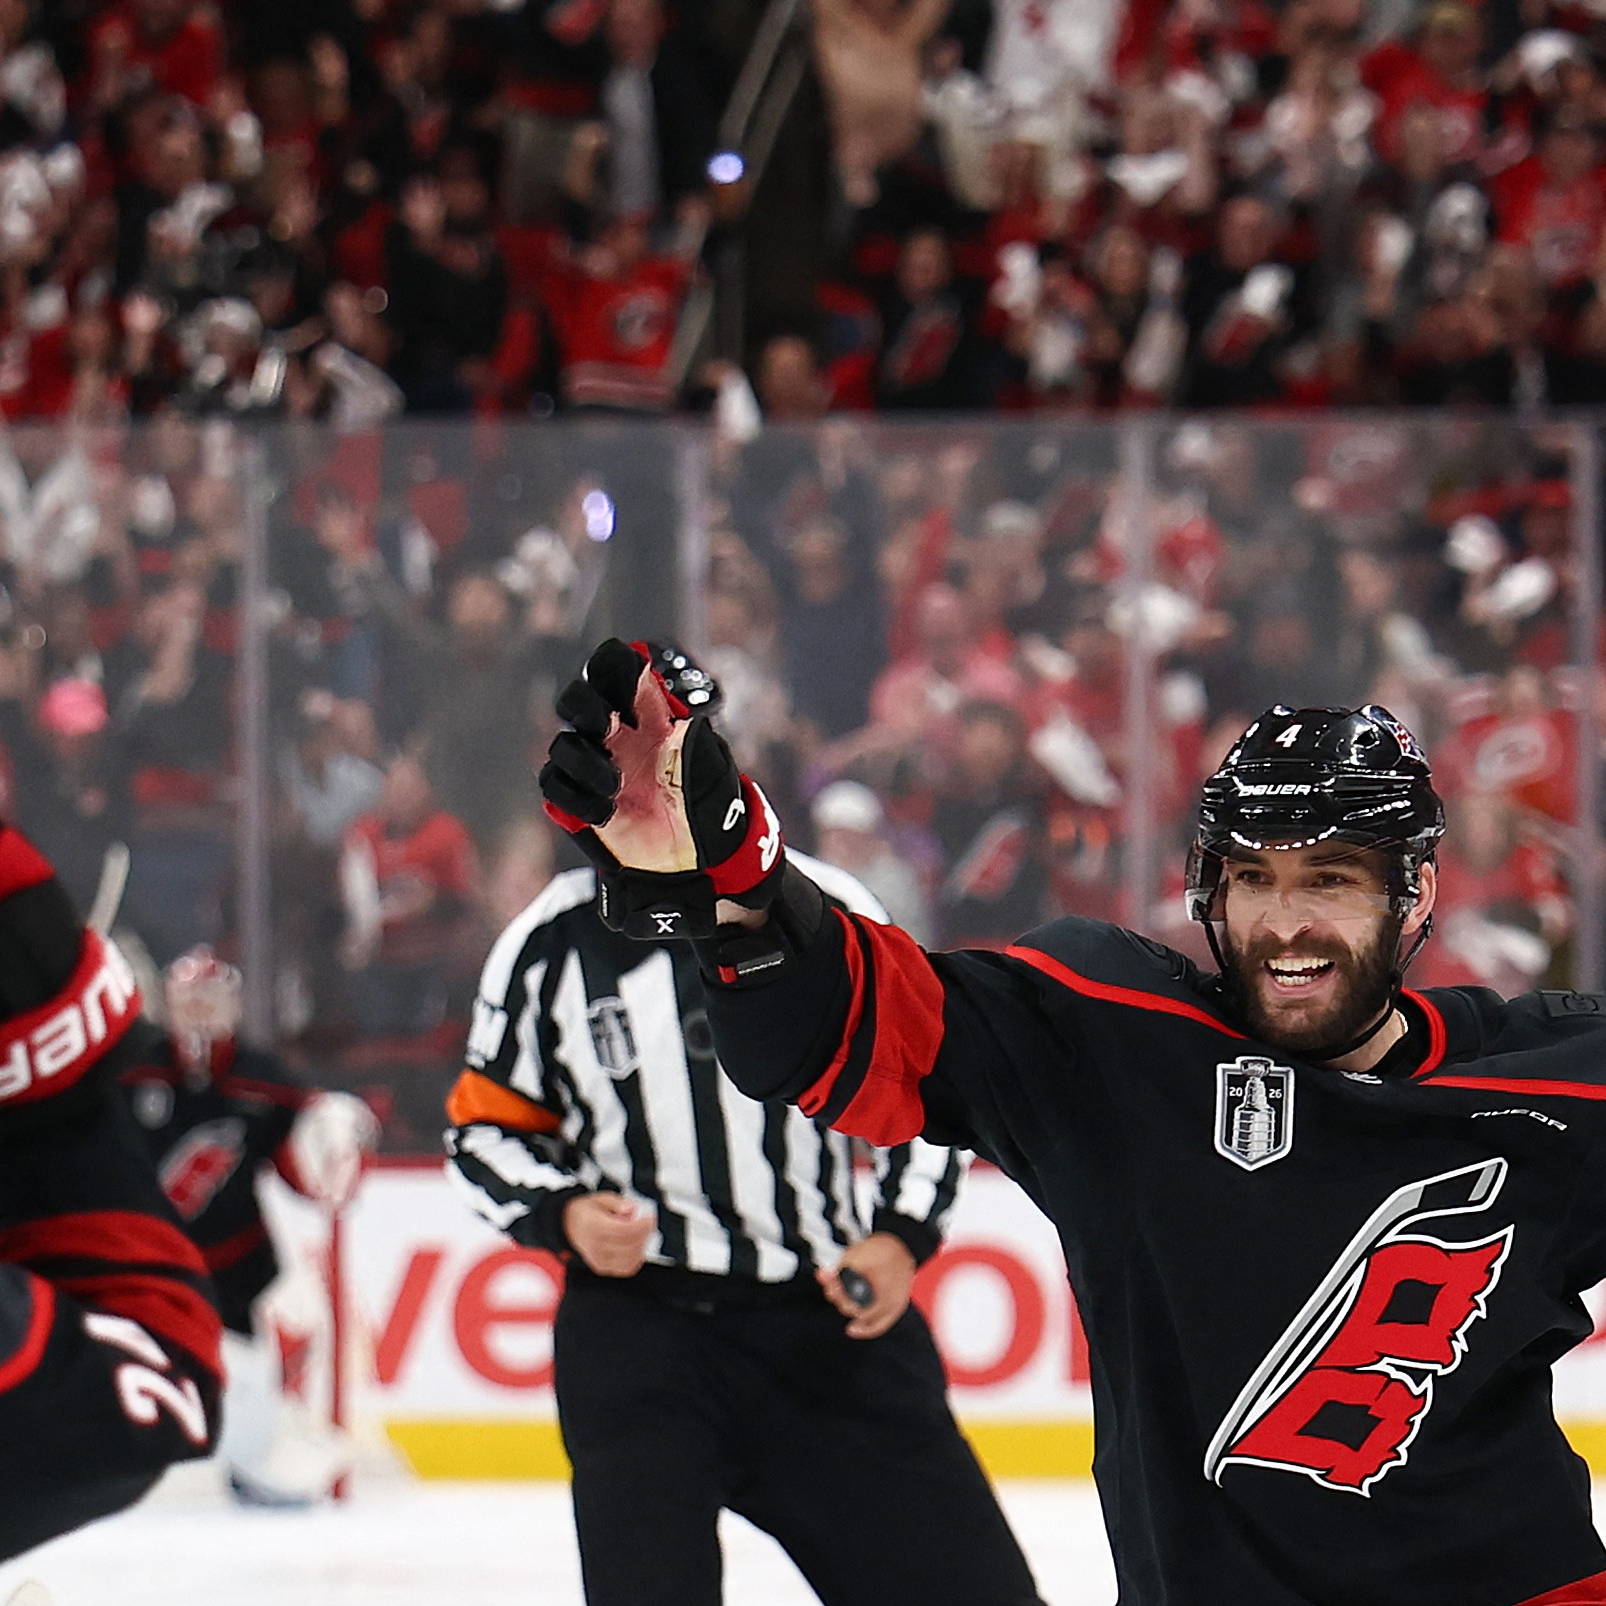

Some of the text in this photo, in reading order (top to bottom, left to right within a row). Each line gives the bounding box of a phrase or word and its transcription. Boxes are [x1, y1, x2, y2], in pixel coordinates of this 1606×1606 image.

[1275, 724, 1303, 748] 4
[1237, 783, 1311, 797] BAUER
[1229, 1086, 1282, 1099] 20 26
